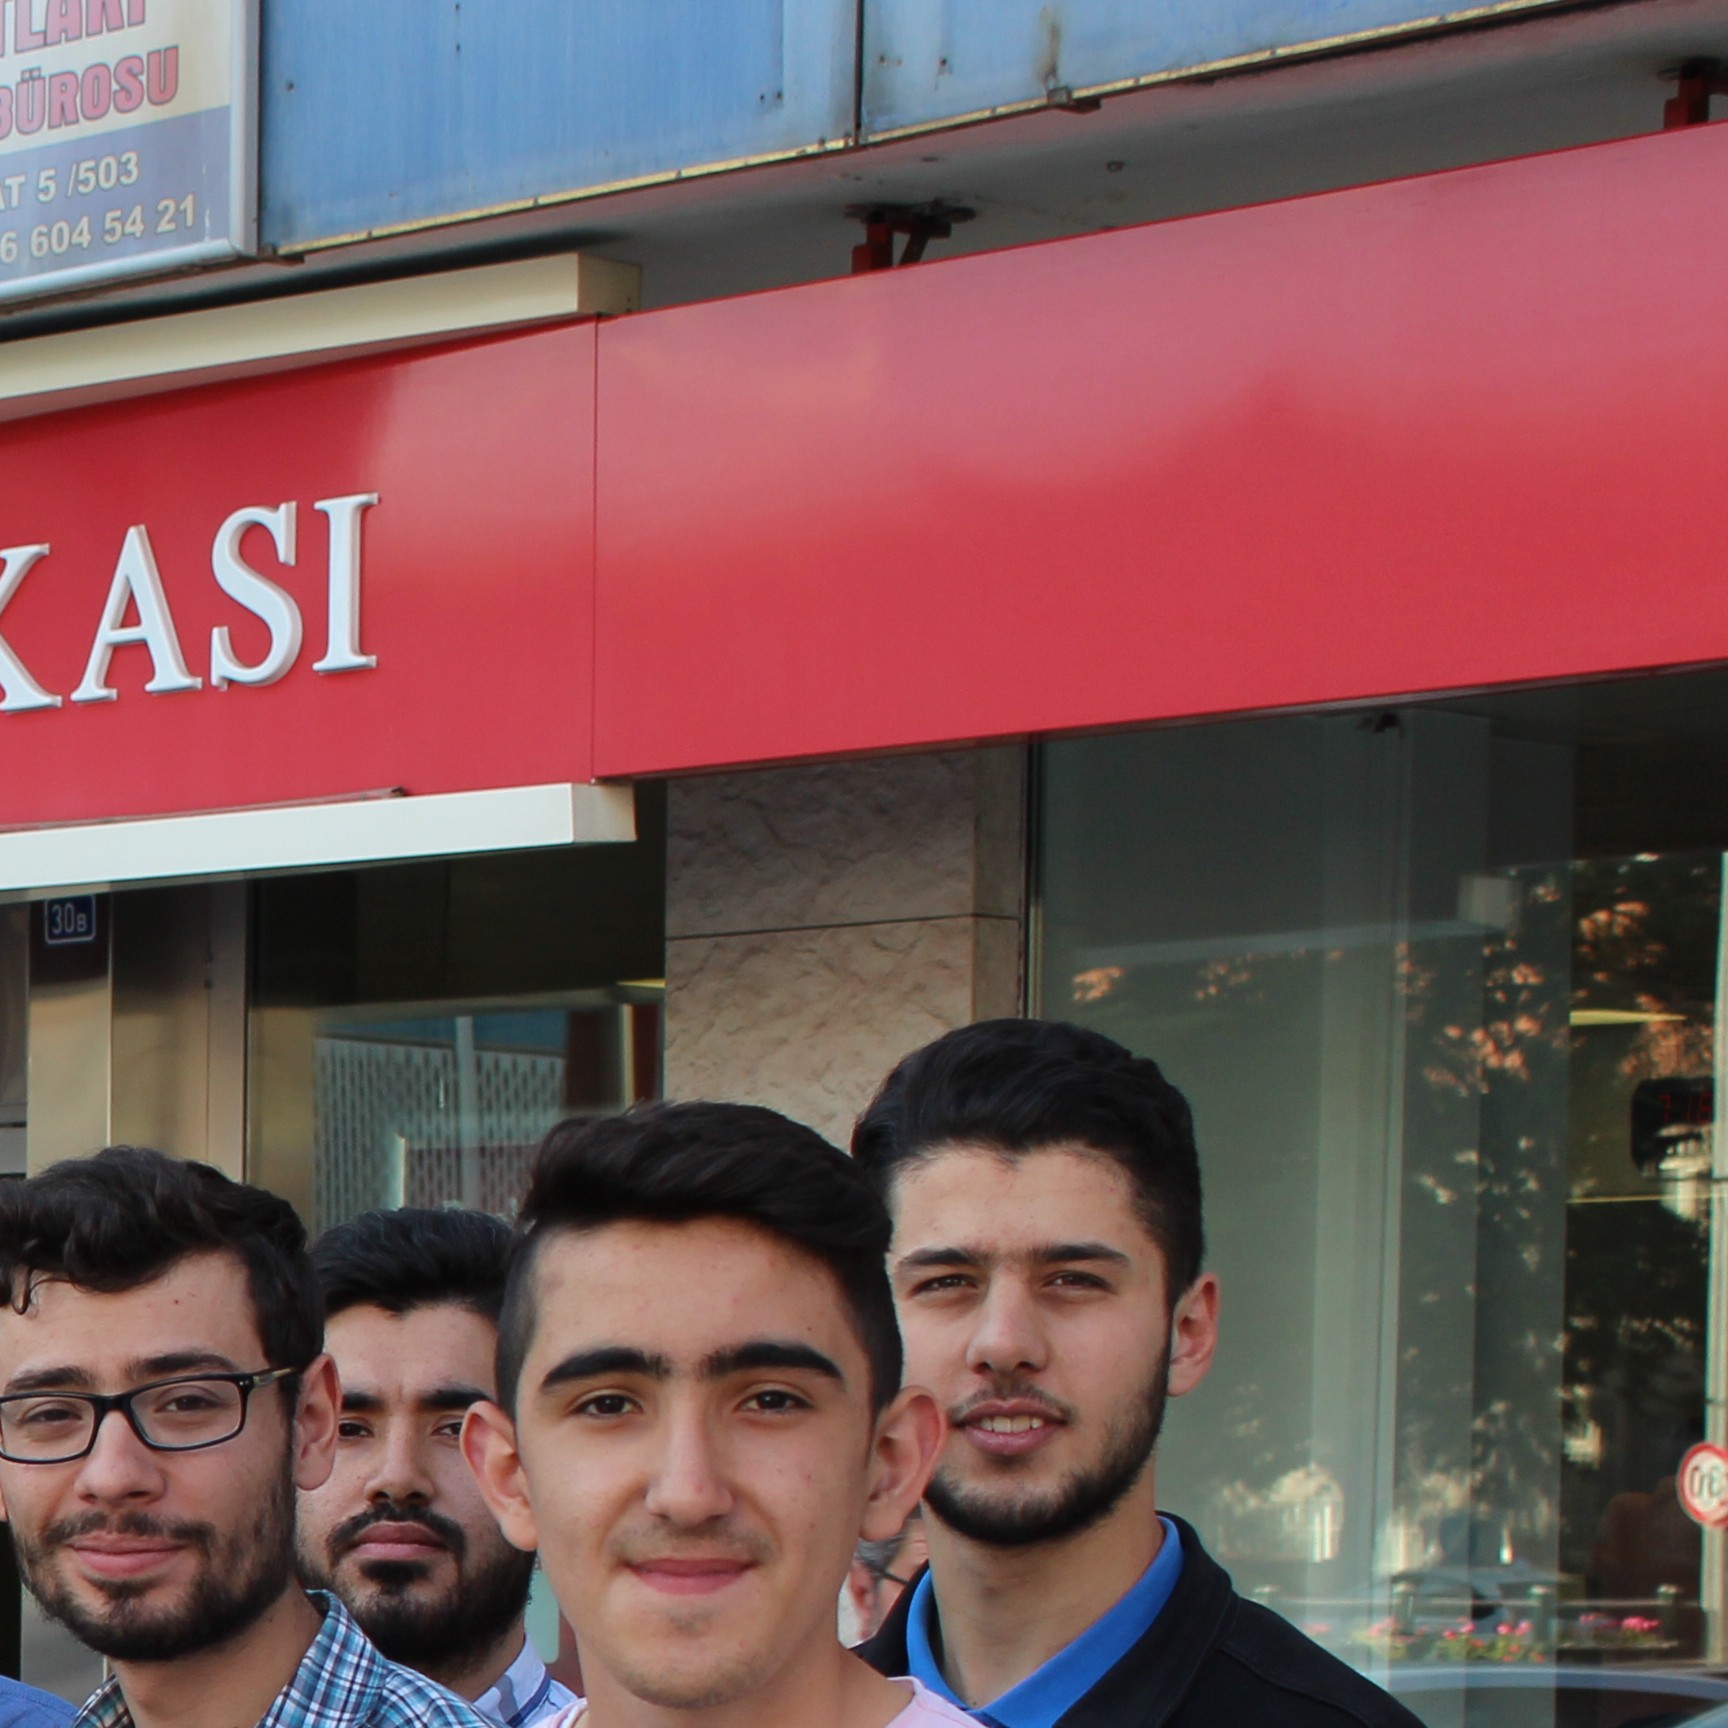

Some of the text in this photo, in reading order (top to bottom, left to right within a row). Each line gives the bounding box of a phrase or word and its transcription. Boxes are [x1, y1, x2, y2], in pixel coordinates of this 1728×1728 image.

[35, 169, 58, 201] 5
[67, 152, 141, 198] /503
[29, 216, 92, 258] 604
[101, 206, 144, 245] 54
[155, 193, 197, 232] 21
[50, 902, 89, 937] 30B
